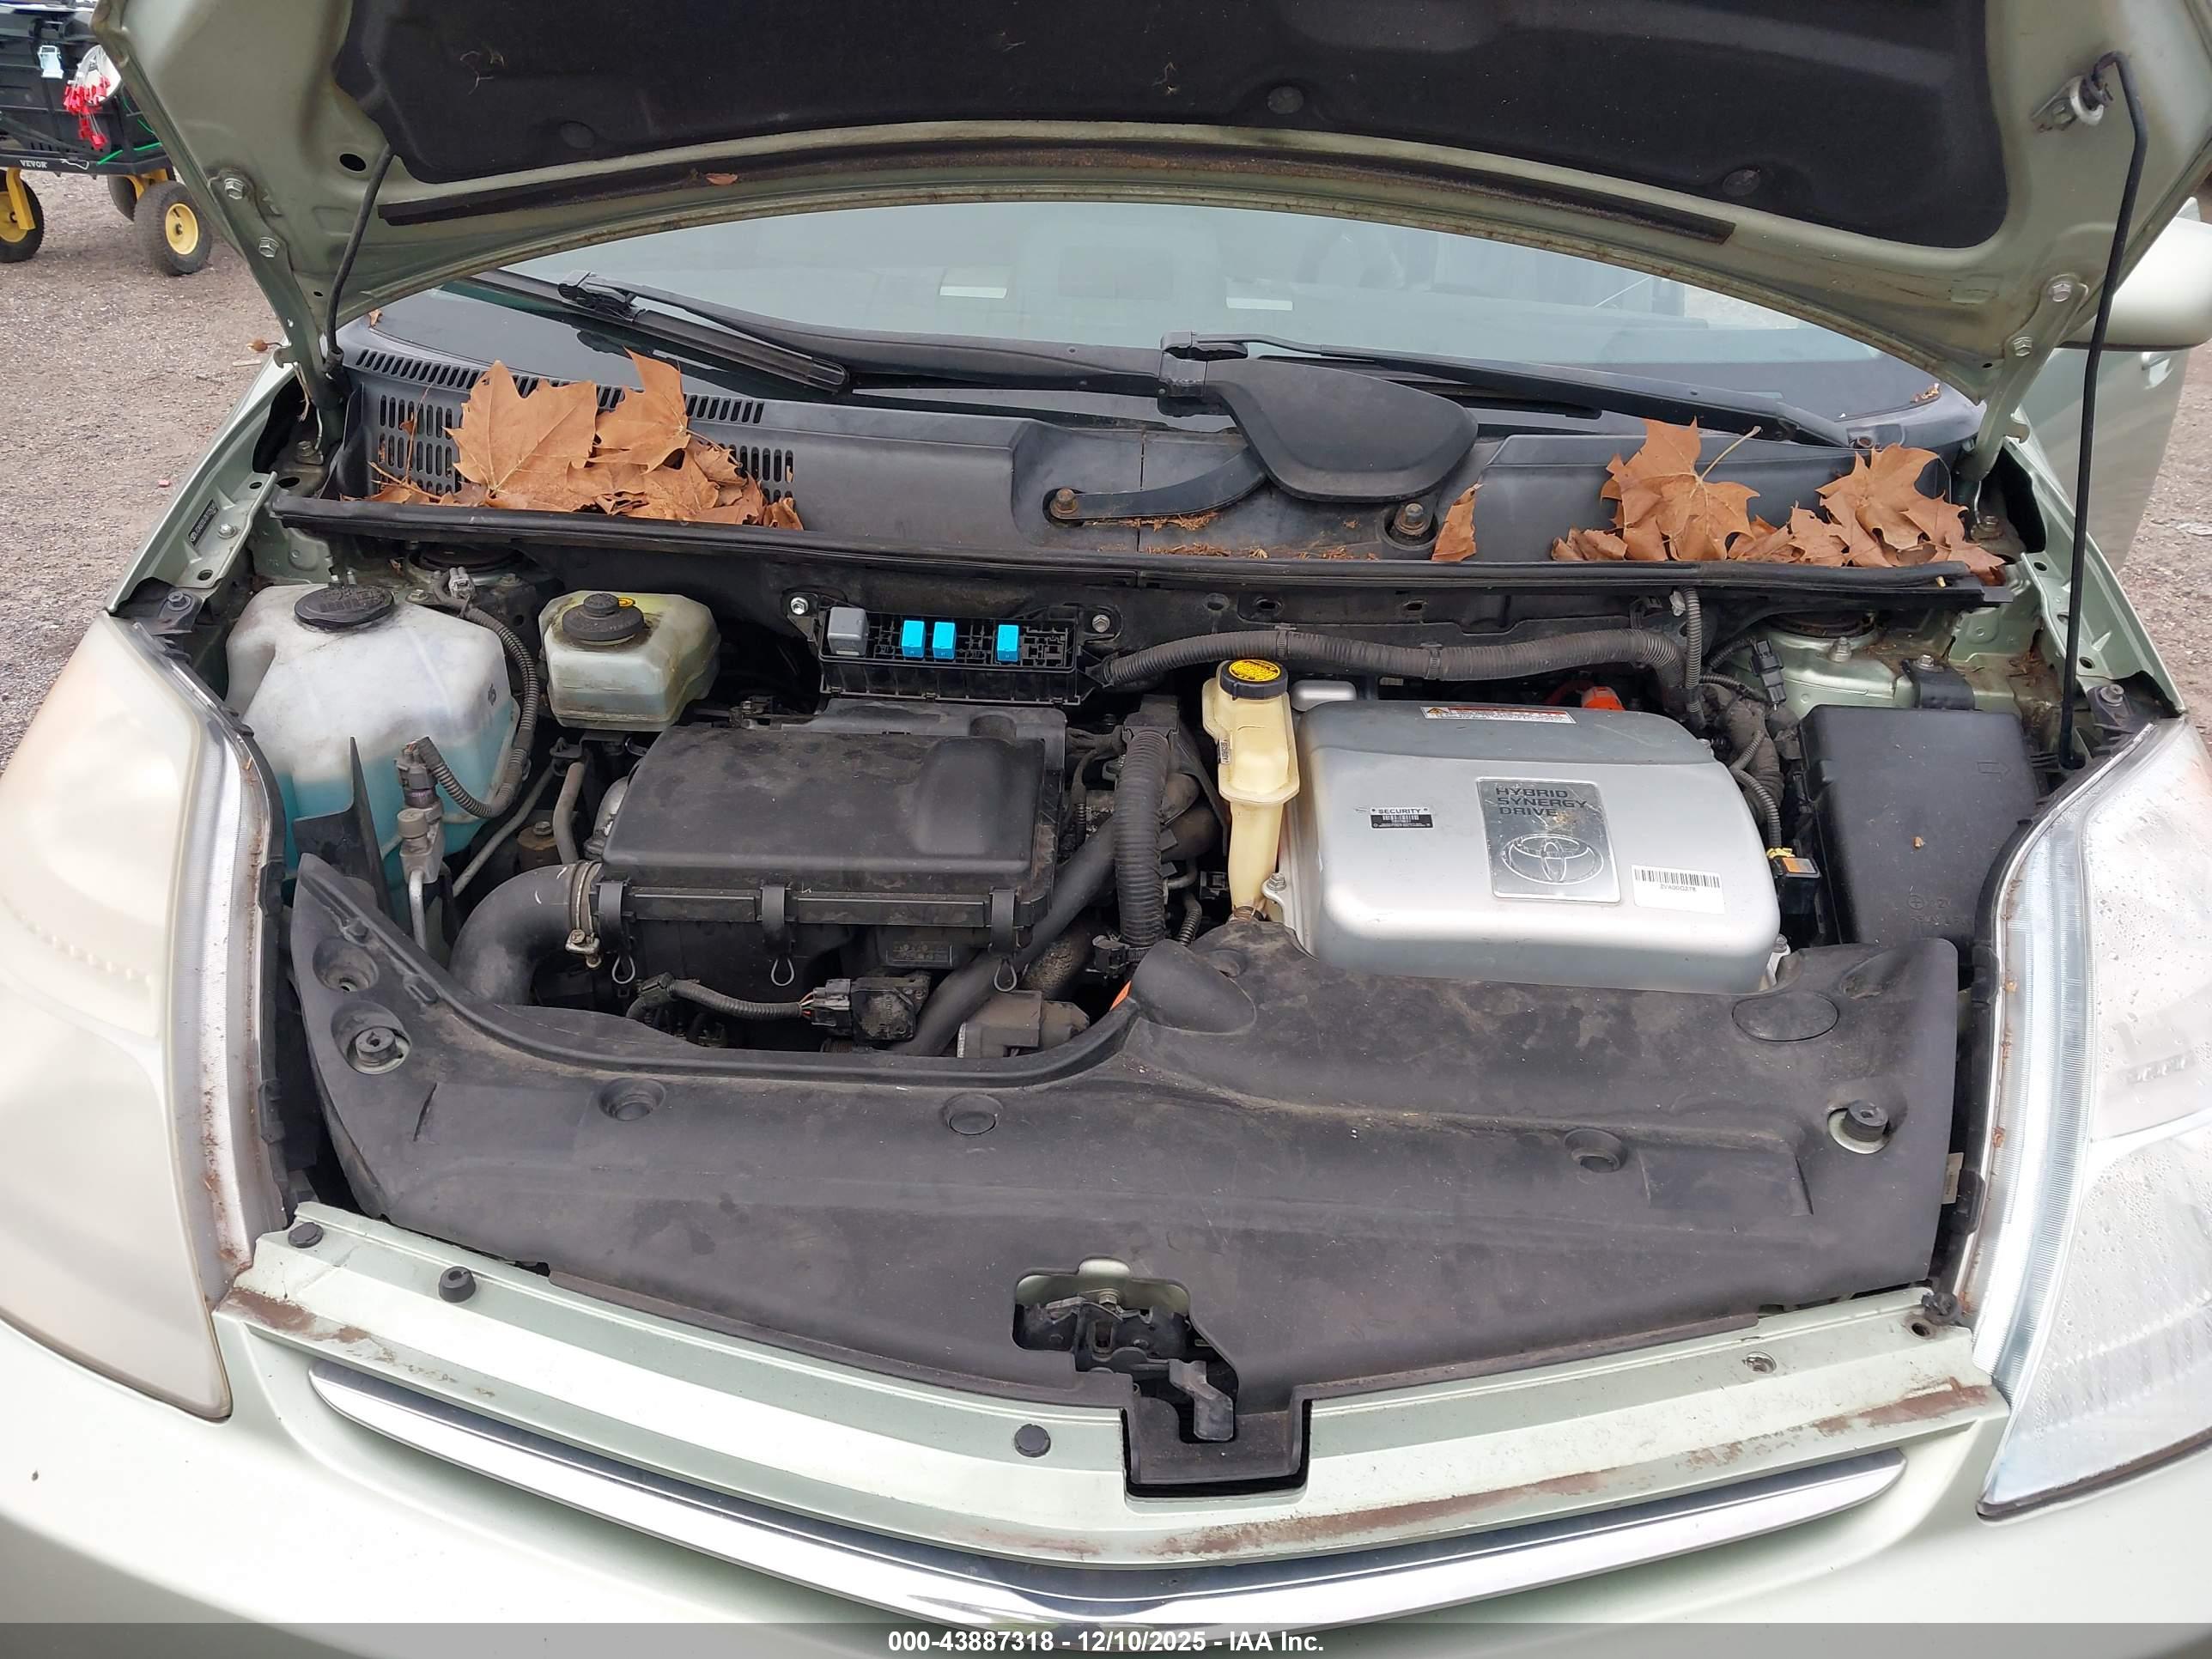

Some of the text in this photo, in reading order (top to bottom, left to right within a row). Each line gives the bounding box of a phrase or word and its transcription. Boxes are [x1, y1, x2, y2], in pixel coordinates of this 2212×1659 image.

[1496, 787, 1568, 798] HYBRID
[1497, 797, 1587, 808] SYNERGY
[1499, 807, 1559, 817] DRIVE
